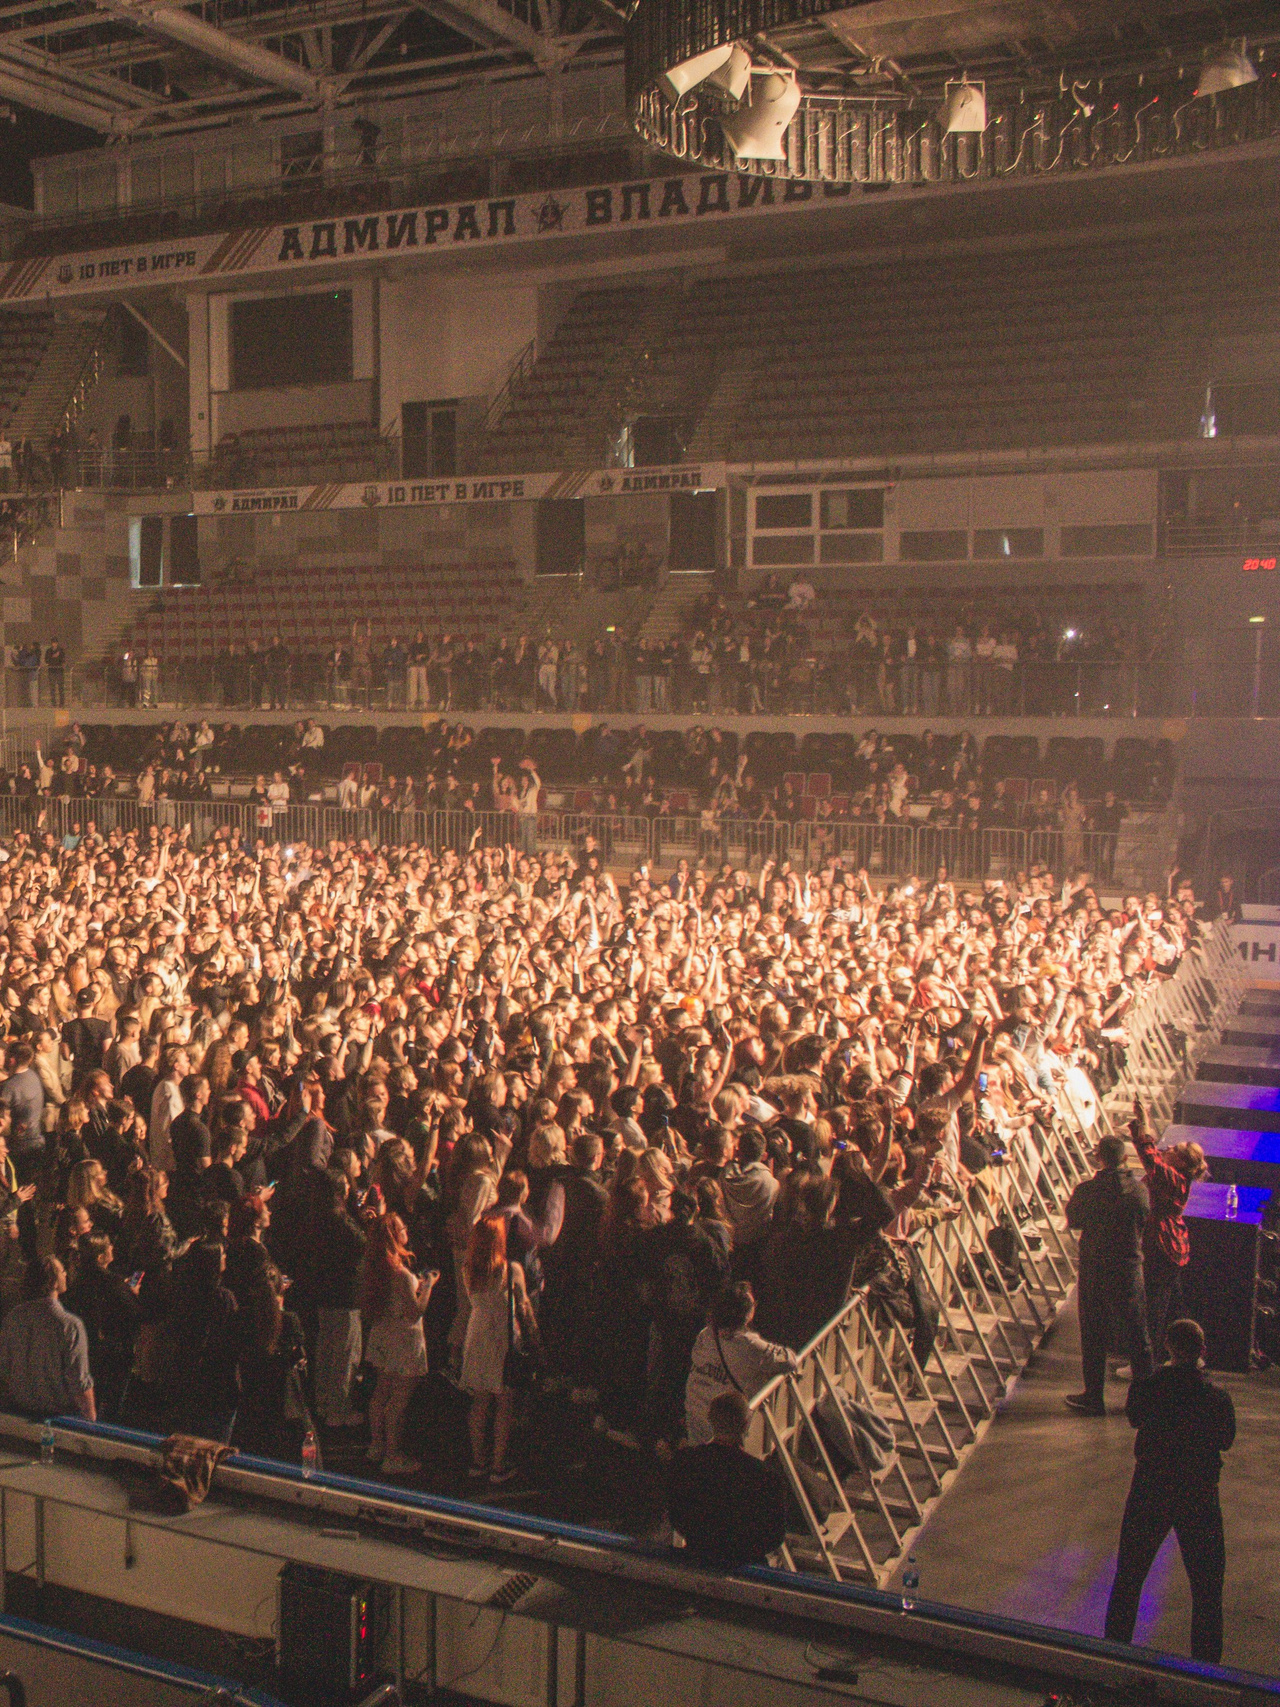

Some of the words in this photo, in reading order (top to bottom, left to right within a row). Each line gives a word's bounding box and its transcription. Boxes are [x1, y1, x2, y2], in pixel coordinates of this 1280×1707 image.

[278, 199, 516, 261] АДМИРАЛ
[80, 263, 95, 280] 10
[99, 258, 133, 277] ЛЕТ
[137, 256, 148, 272] В
[152, 250, 196, 269] ИГРЕ
[388, 486, 407, 503] 10
[410, 484, 450, 502] ЛЕТ
[455, 483, 467, 500] В
[473, 479, 524, 499] ИГРЕ
[621, 472, 702, 491] АДМИРАЛ
[232, 495, 298, 511] АДМИРАЛ
